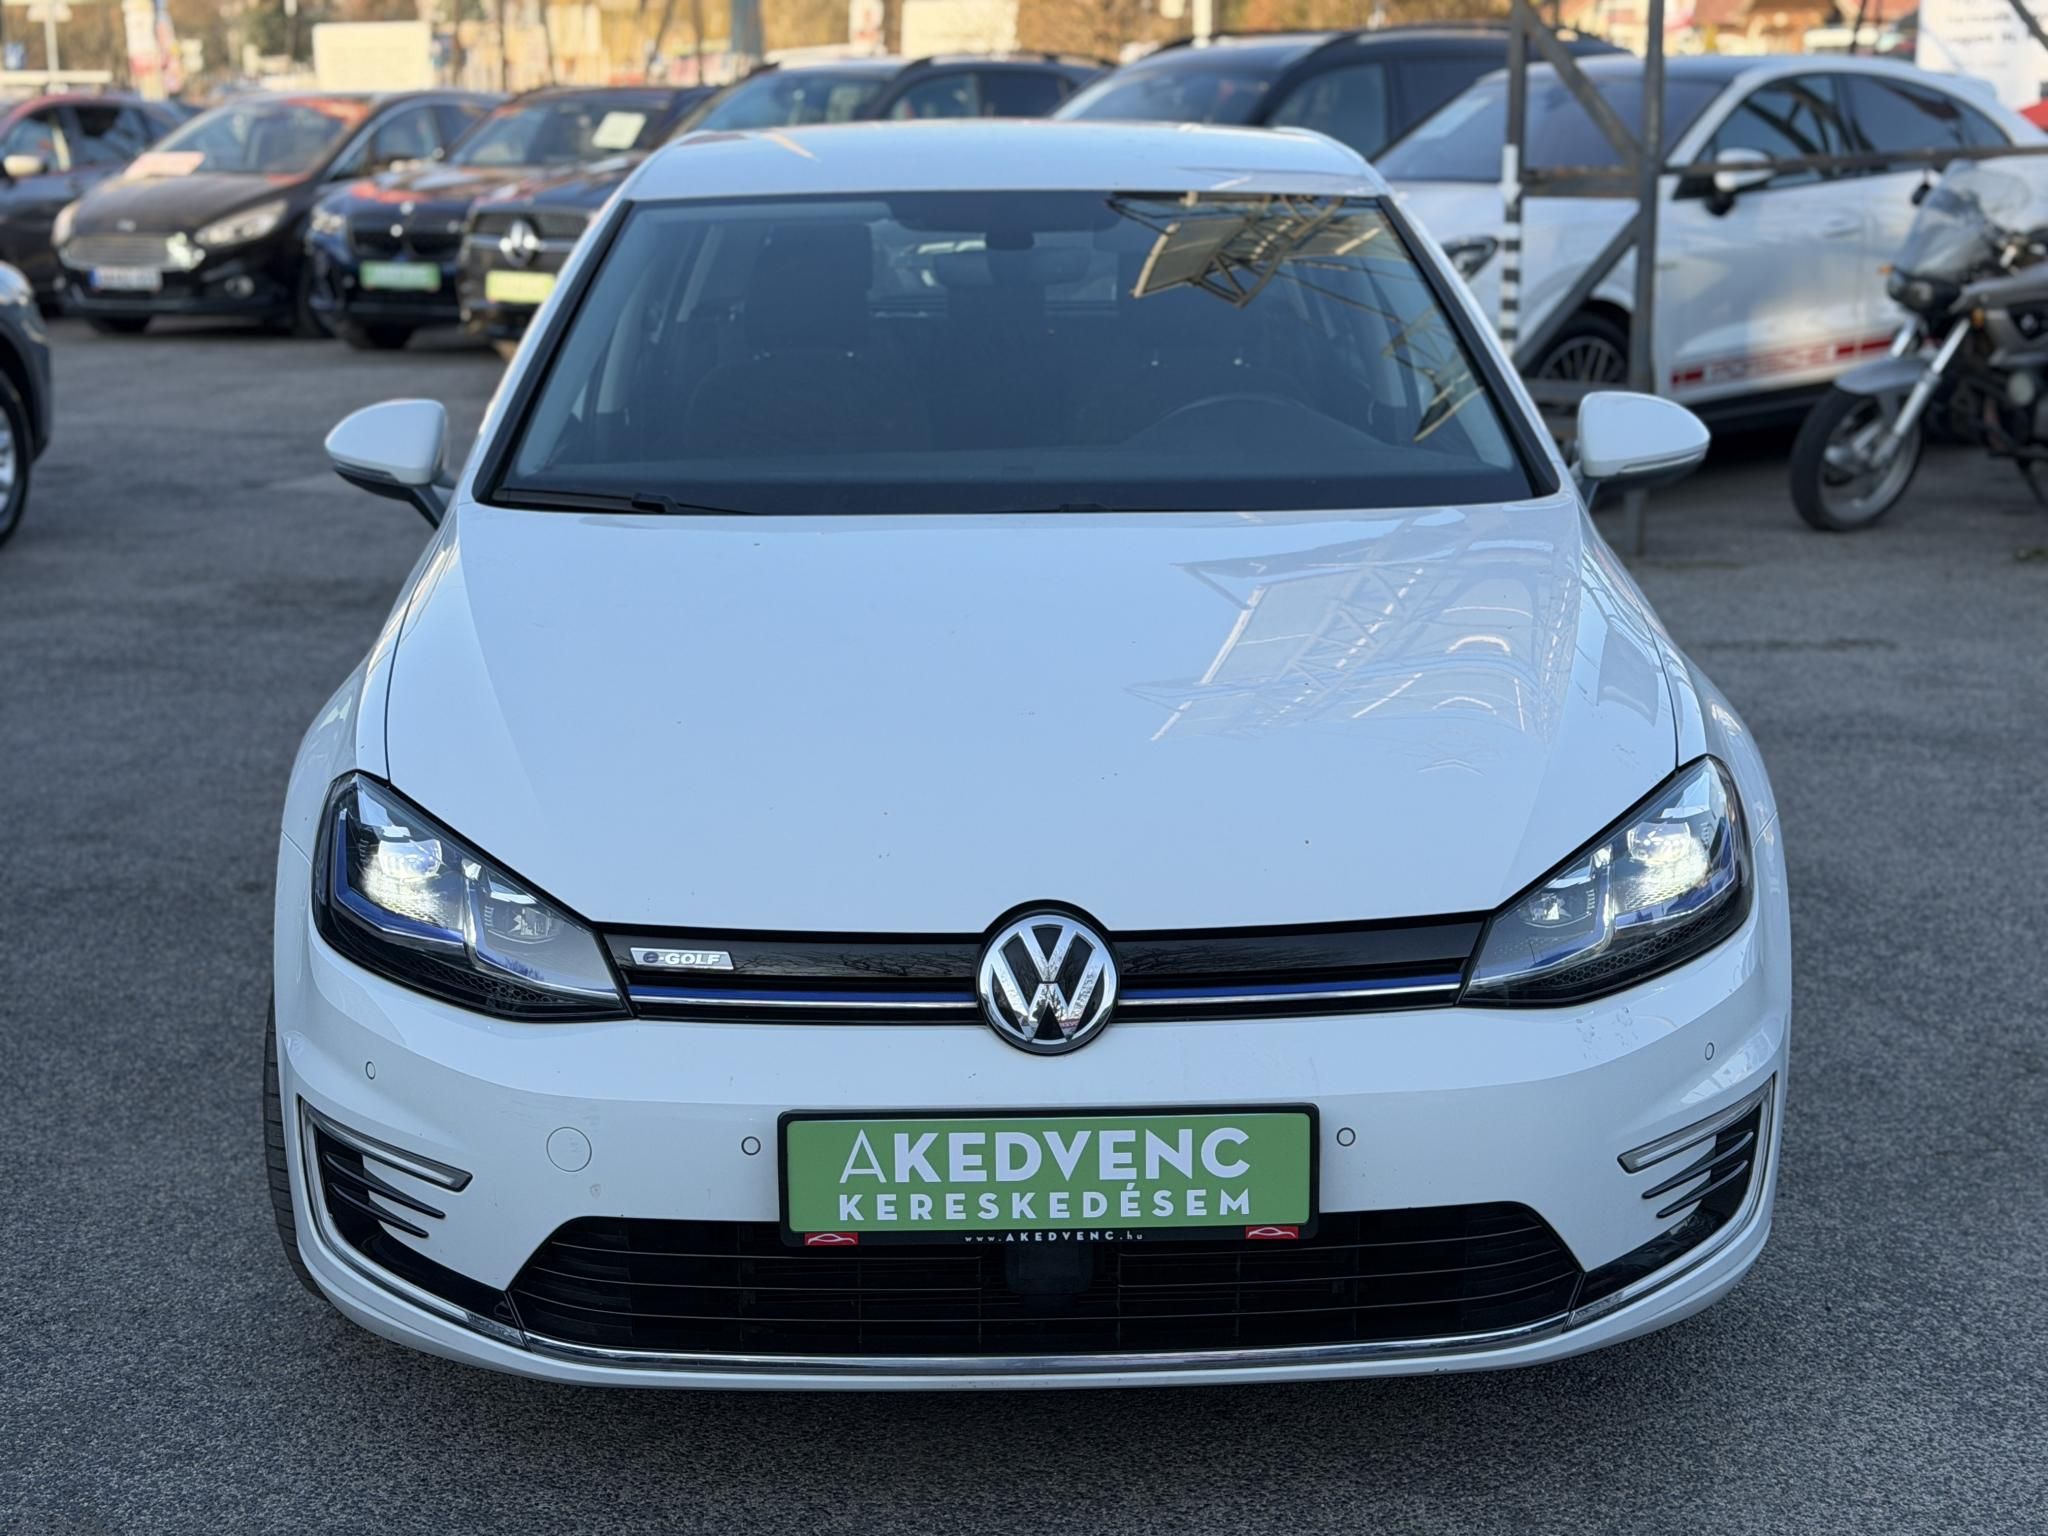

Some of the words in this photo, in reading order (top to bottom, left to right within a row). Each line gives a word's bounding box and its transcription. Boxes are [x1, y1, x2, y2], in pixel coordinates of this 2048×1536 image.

[979, 914, 1117, 1045] VW
[839, 1126, 1251, 1184] AKEDVENC
[838, 1182, 1250, 1222] KERESKEDÉSEM
[965, 1230, 1143, 1242] www.AKEDVENC.hu
